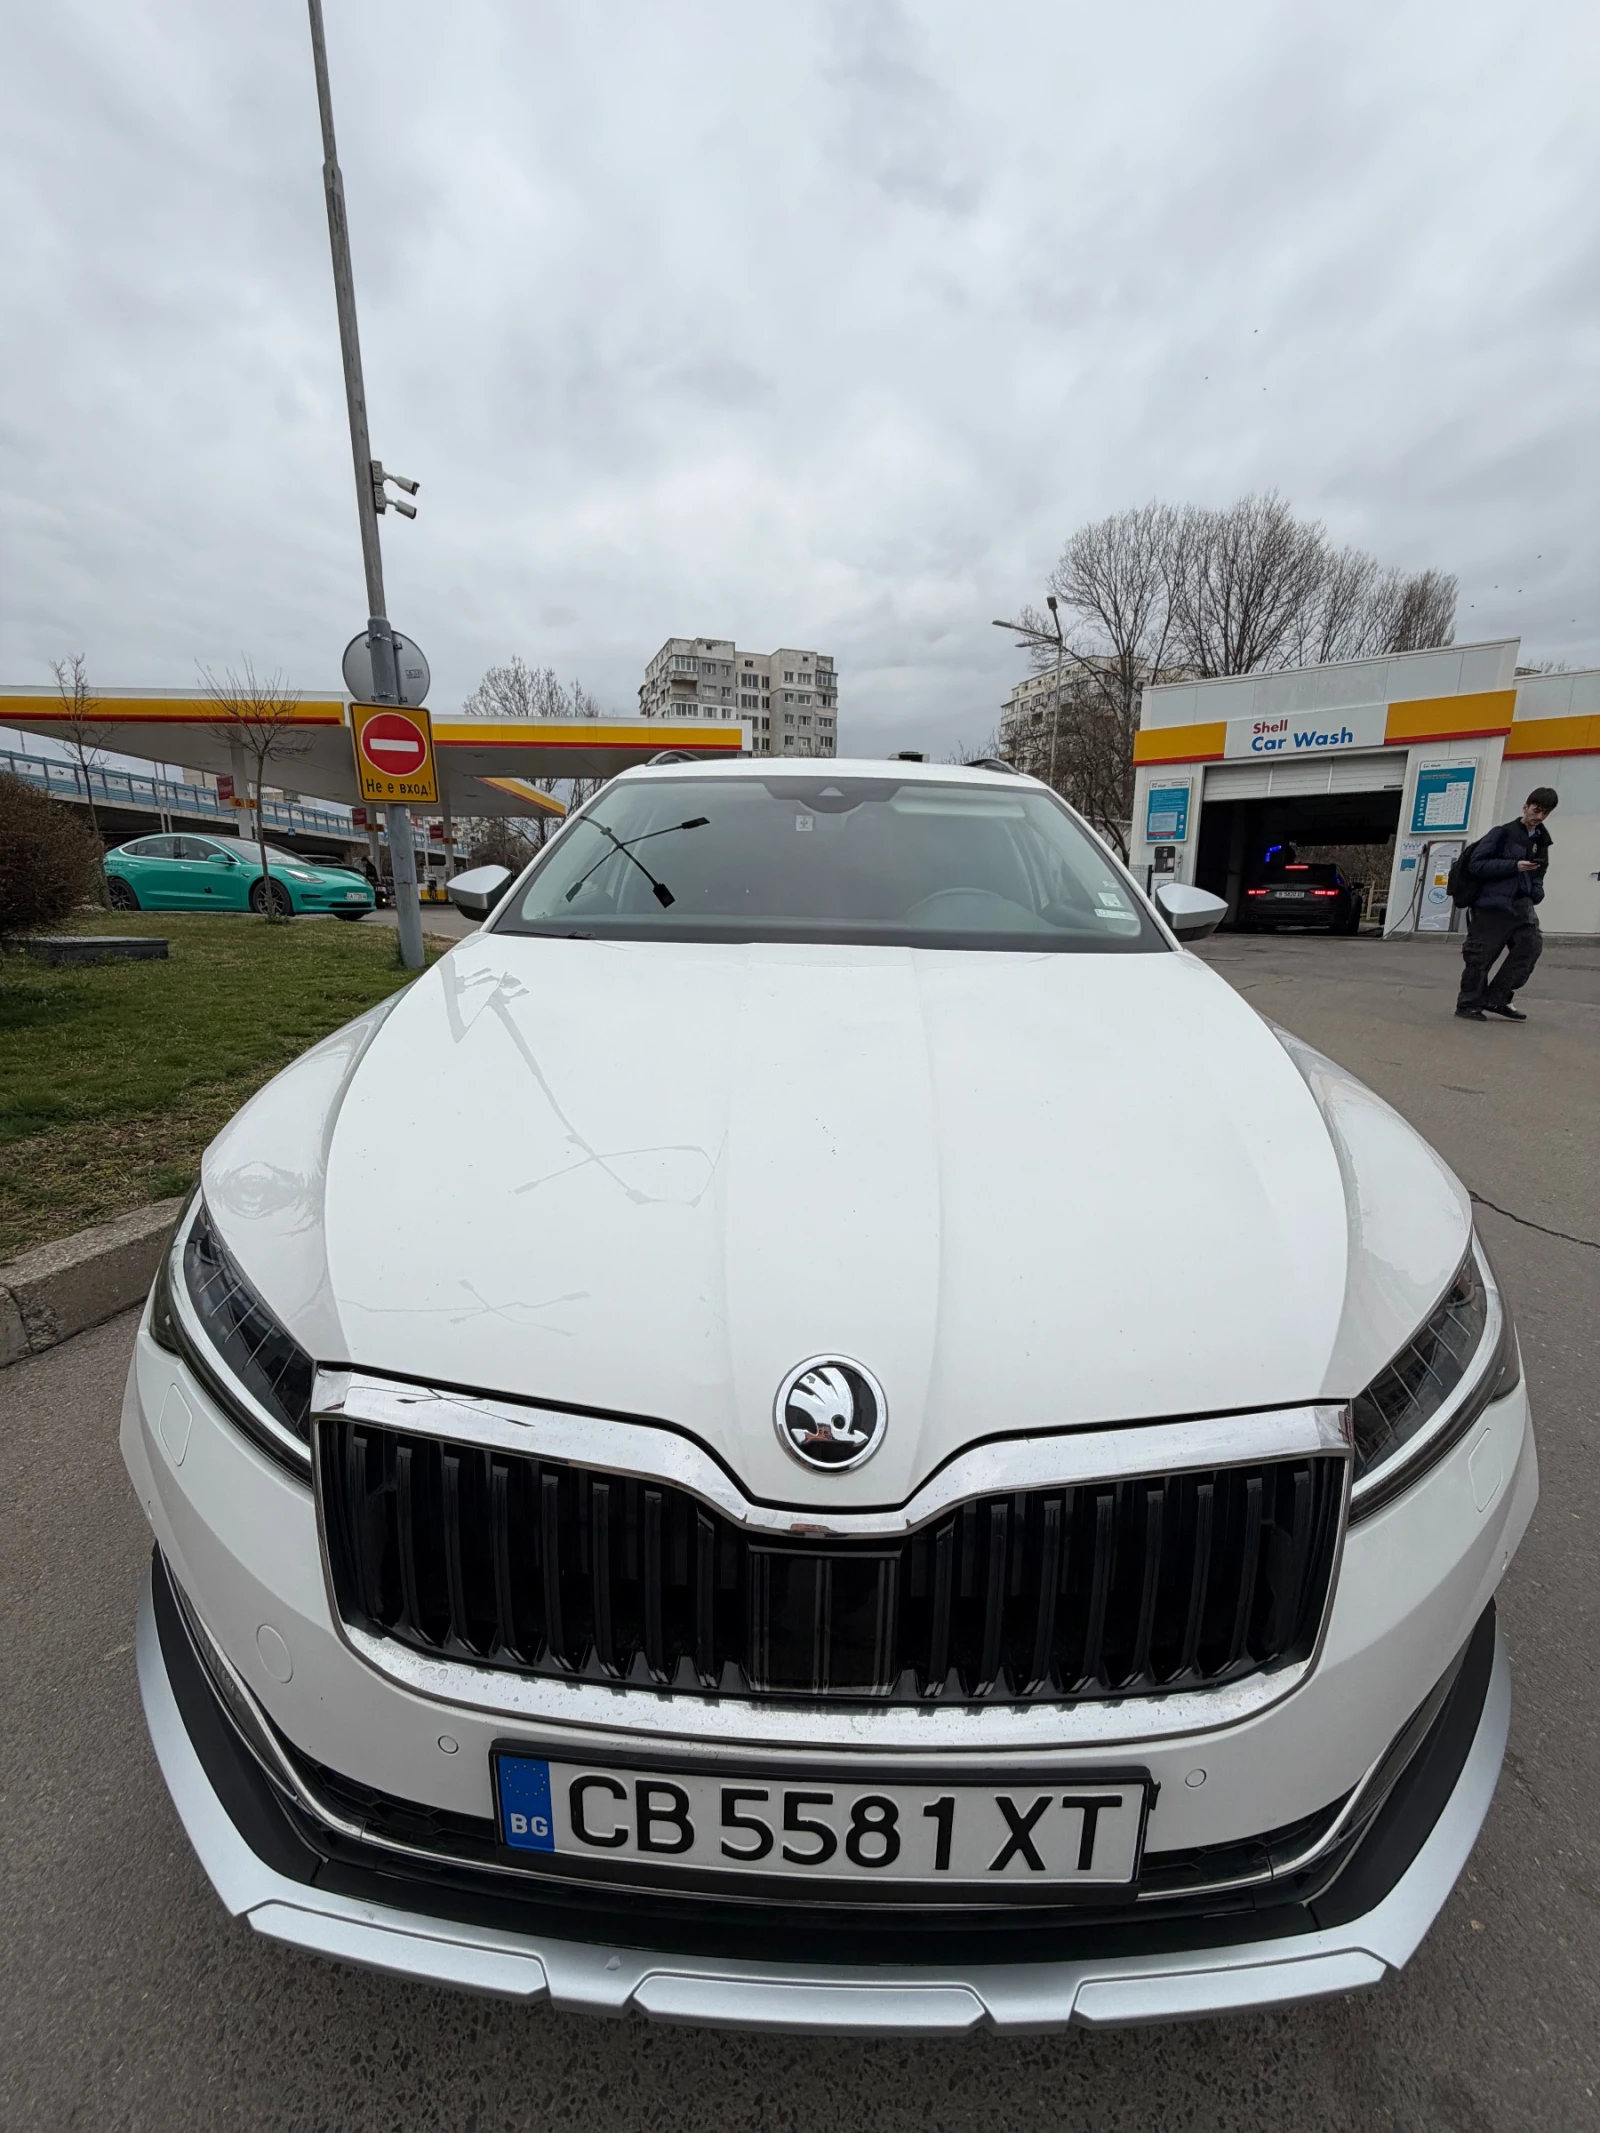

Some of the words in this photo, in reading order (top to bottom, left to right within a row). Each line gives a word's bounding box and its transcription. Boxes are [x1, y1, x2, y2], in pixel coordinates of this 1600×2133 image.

[1253, 719, 1288, 734] Shell
[1251, 736, 1287, 751] Car
[1293, 727, 1353, 748] Wash
[366, 778, 382, 793] Не
[387, 782, 394, 793] е
[400, 780, 432, 797] вход!
[235, 799, 241, 807] 6
[249, 800, 255, 808] 5
[510, 1813, 548, 1837] BG
[569, 1773, 694, 1853] CB
[721, 1787, 955, 1870] 5581
[987, 1795, 1123, 1871] XT
